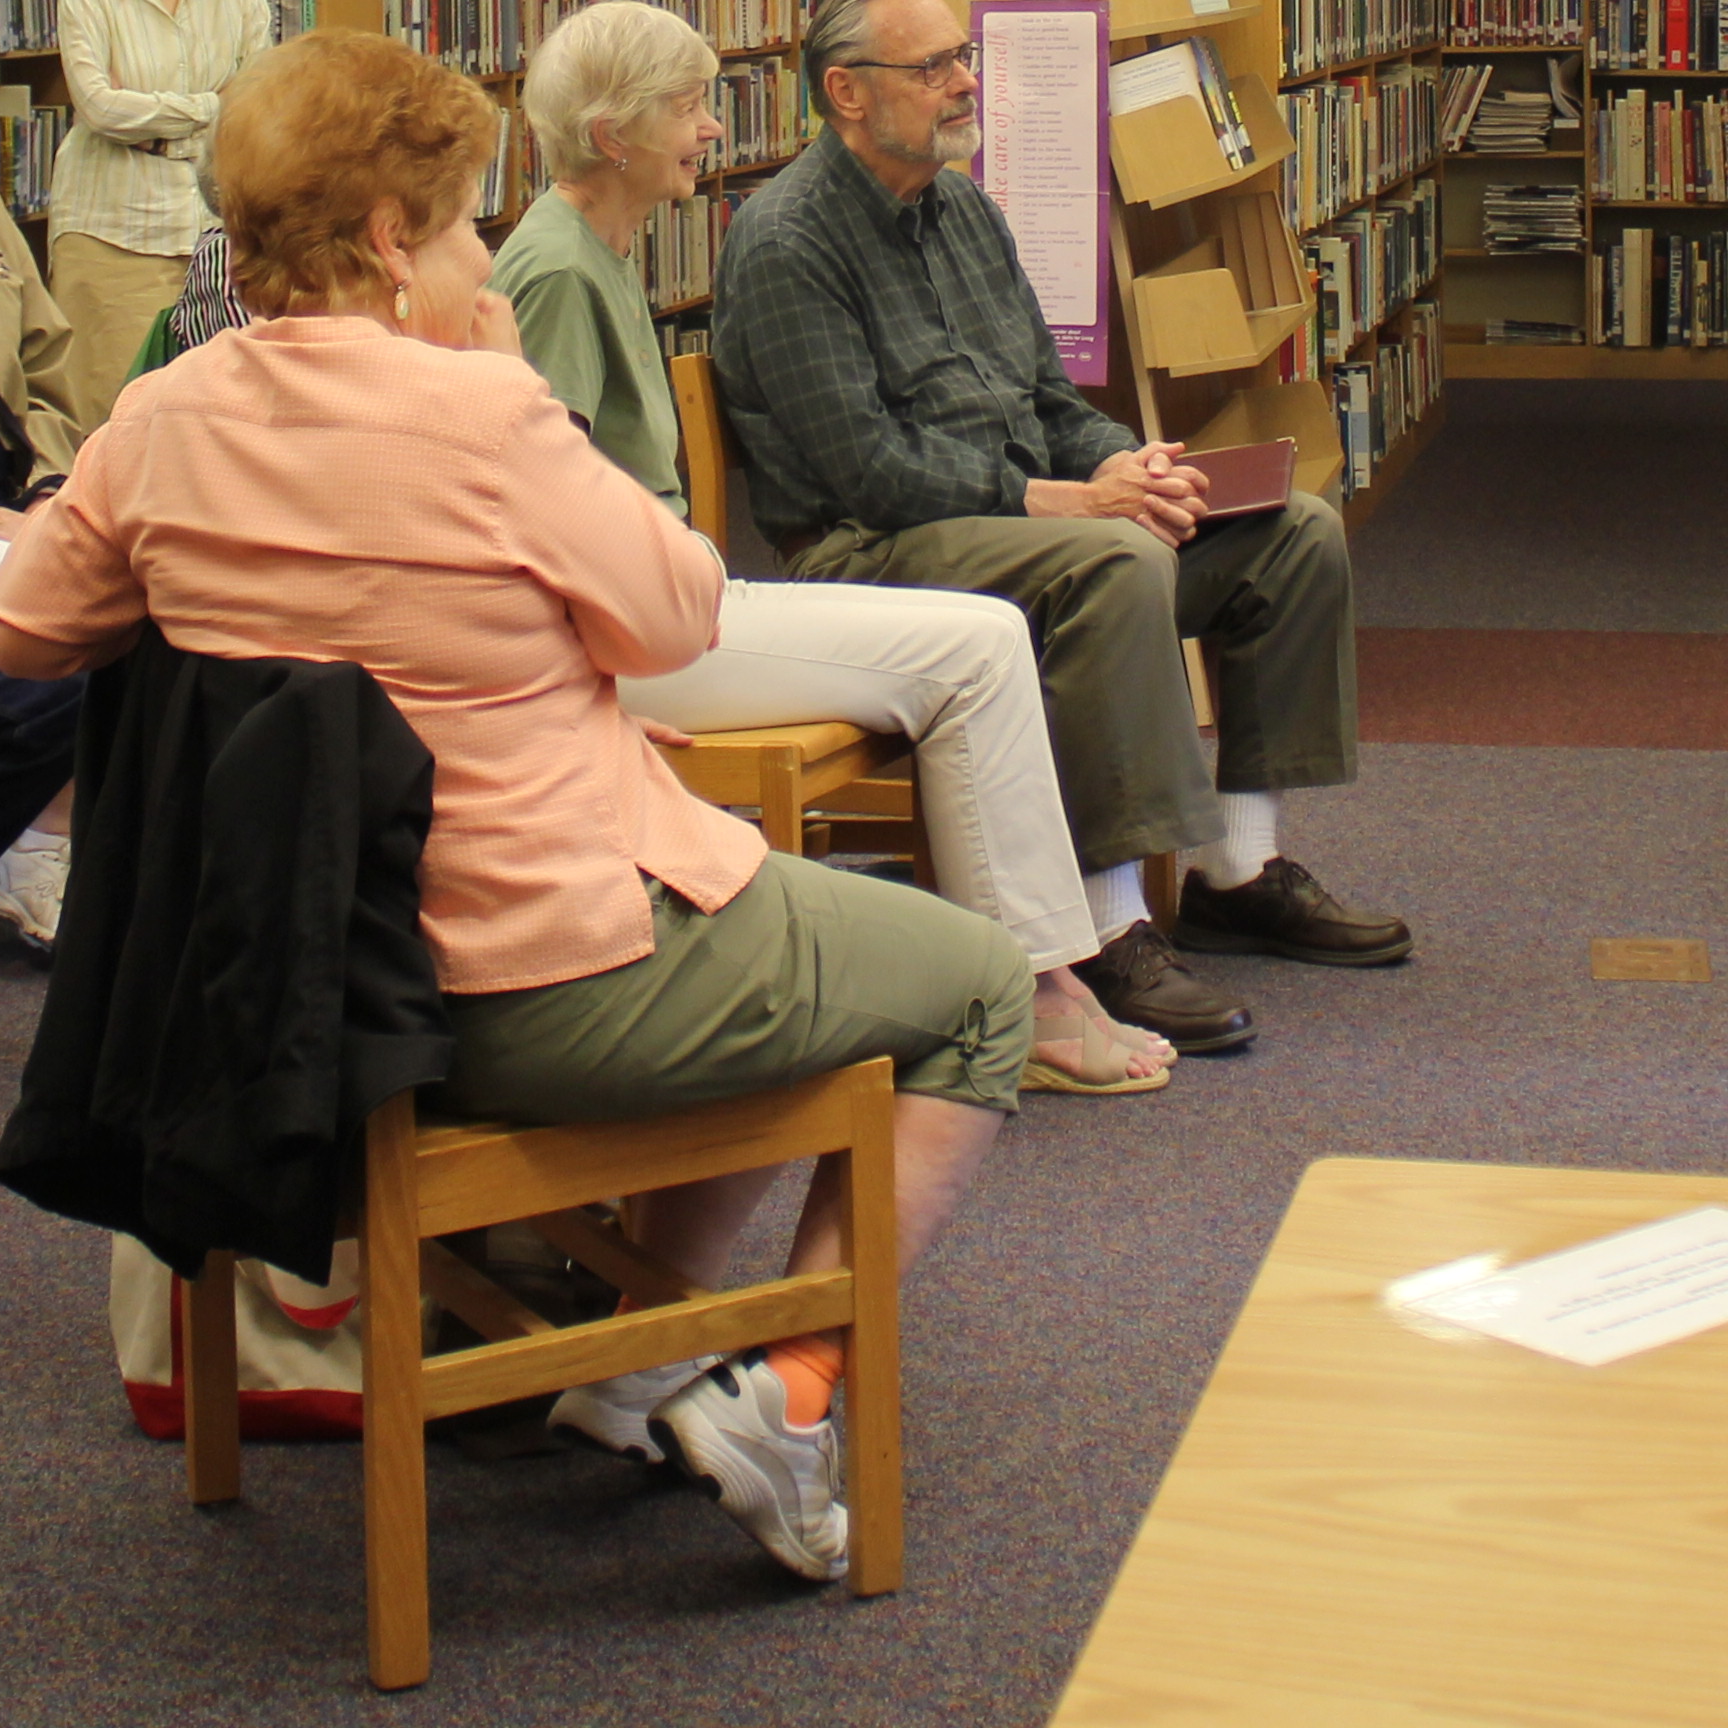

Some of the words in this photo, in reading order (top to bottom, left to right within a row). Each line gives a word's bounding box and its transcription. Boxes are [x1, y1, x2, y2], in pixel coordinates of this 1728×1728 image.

[986, 31, 1015, 108] yourself
[987, 107, 1016, 129] of
[994, 135, 1009, 171] care
